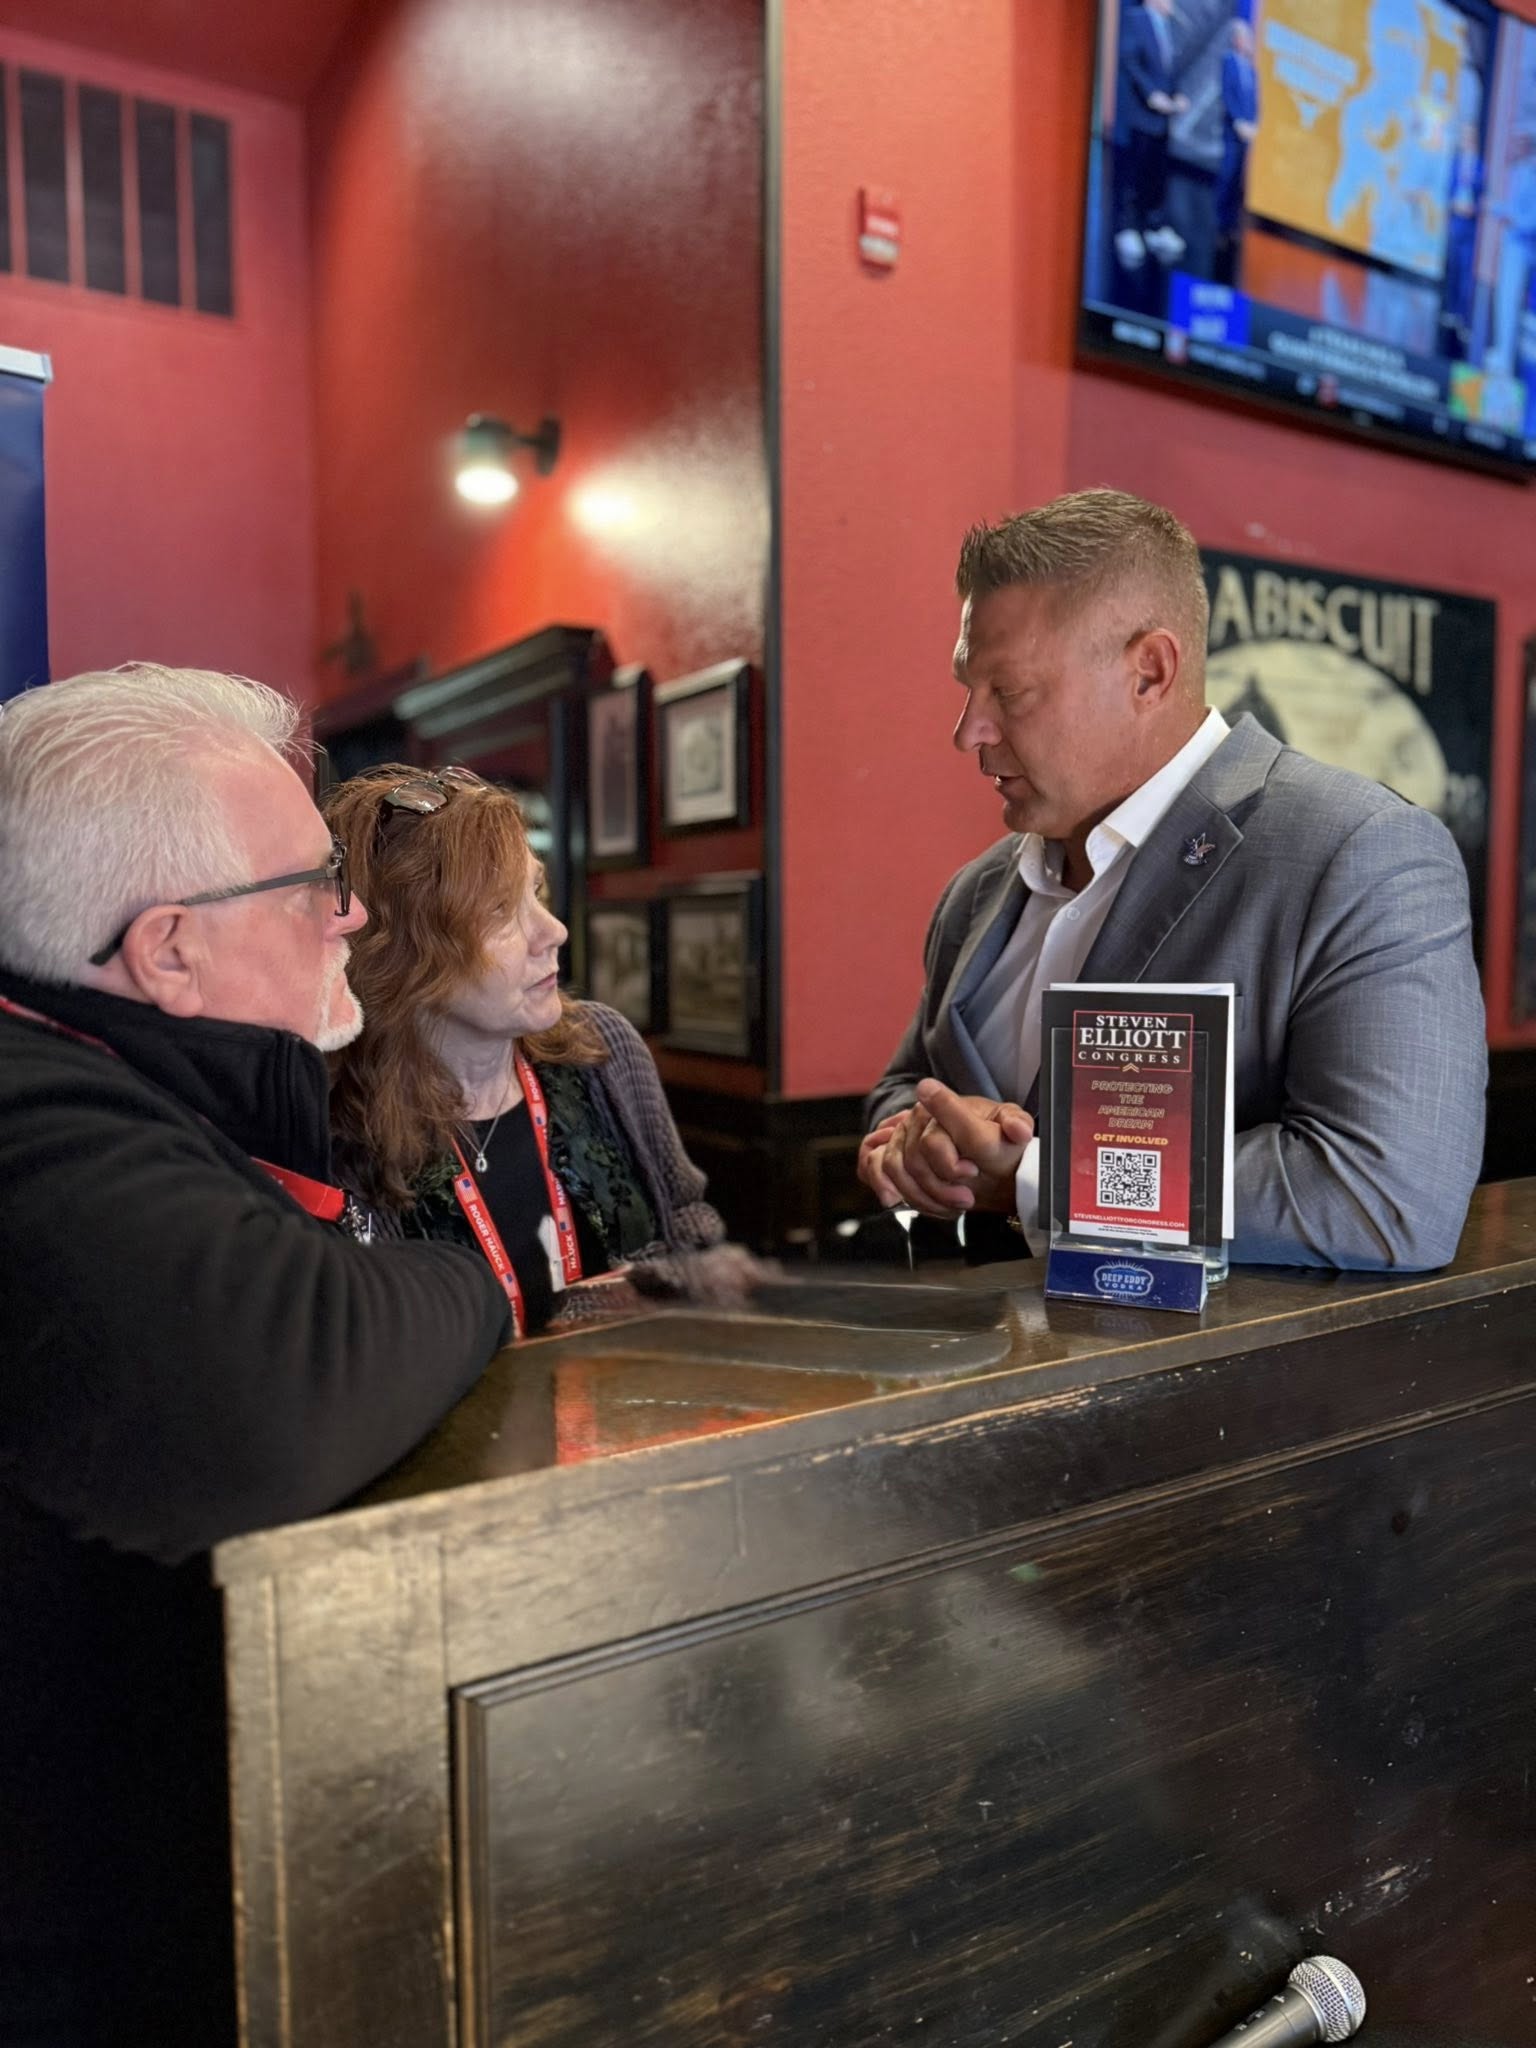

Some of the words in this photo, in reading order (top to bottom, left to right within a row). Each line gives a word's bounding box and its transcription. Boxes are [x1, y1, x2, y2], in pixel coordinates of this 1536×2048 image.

[1208, 565, 1440, 695] ABISCUIT
[1096, 1015, 1168, 1028] STEVEN
[1079, 1027, 1186, 1049] ELLIOTT
[1078, 1051, 1181, 1064] CONGRESS
[1091, 1080, 1174, 1094] PROTECTING
[1119, 1093, 1145, 1105] THE
[1097, 1105, 1165, 1118] AMERICAN
[1108, 1117, 1154, 1130] DREAM
[1093, 1133, 1115, 1142] GET
[1116, 1135, 1169, 1146] INVOLVED
[1073, 1213, 1185, 1228] STEVENELLIOTTFORCONGRESS.COM
[468, 1203, 490, 1237] ROGER
[485, 1237, 505, 1271] HAUCK
[565, 1234, 577, 1269] HAUCK
[1101, 1272, 1123, 1282] DEEP
[1124, 1274, 1146, 1285] EDDY
[1104, 1282, 1143, 1291] VODKA
